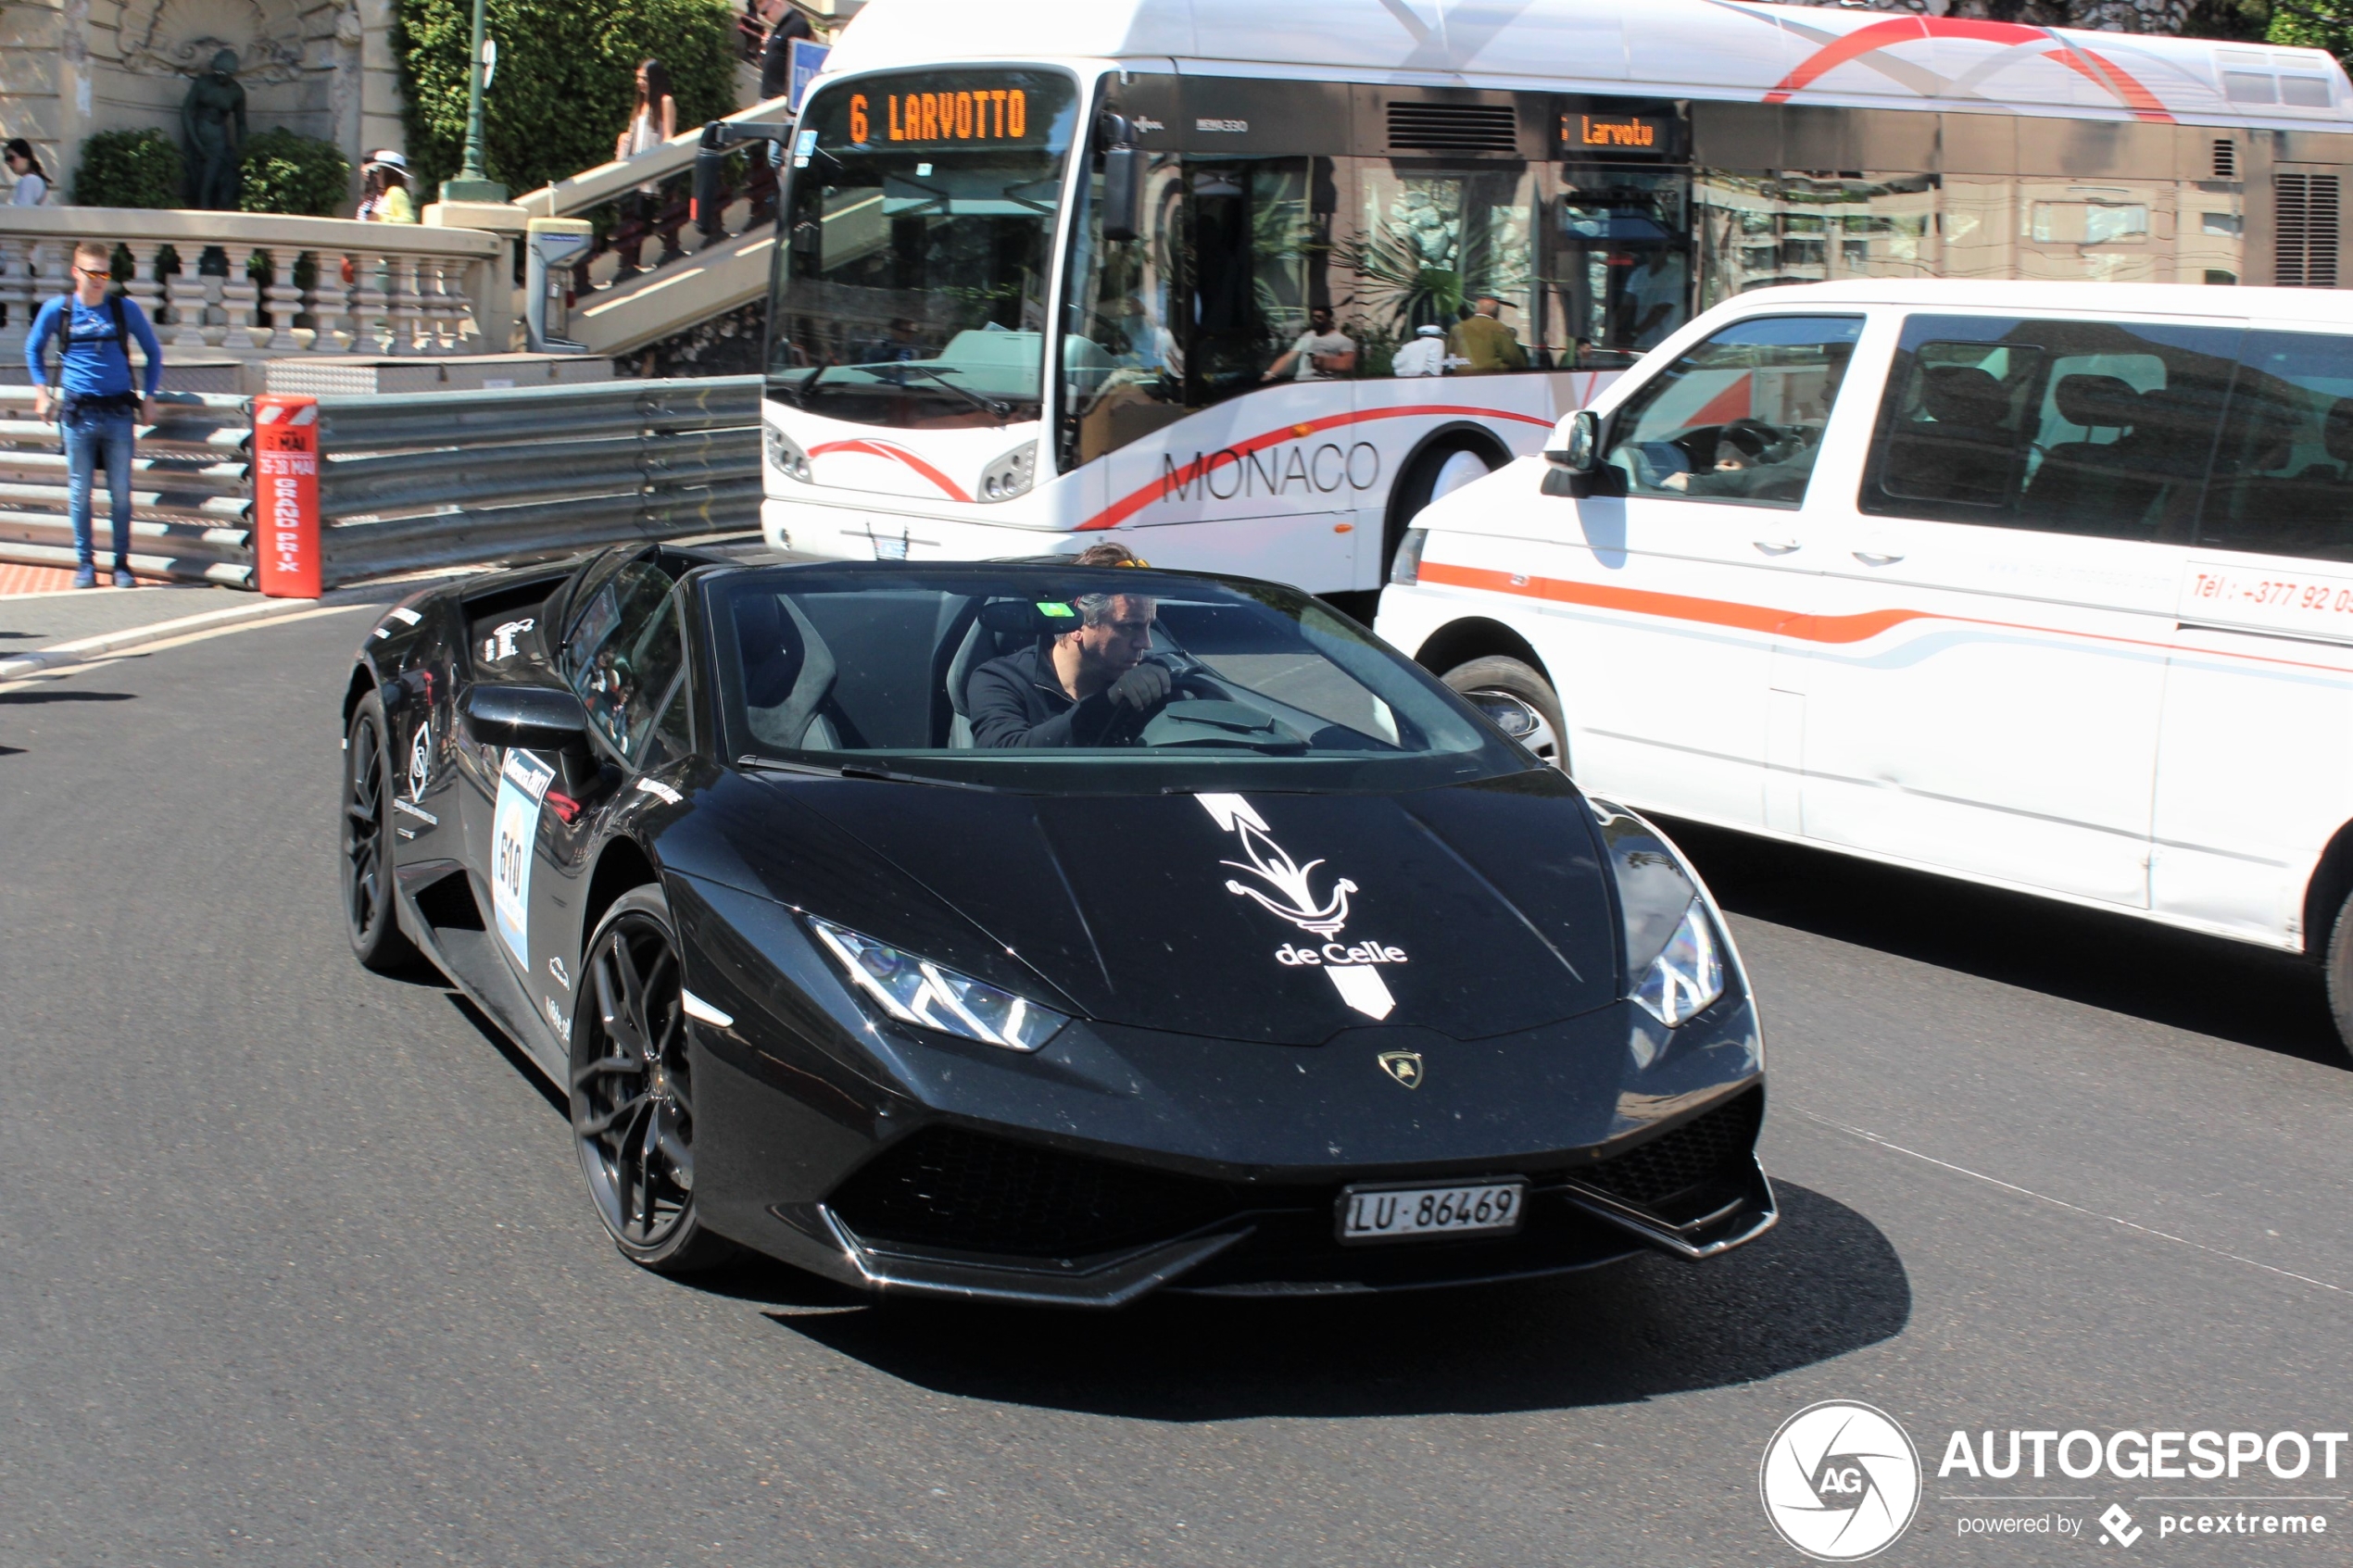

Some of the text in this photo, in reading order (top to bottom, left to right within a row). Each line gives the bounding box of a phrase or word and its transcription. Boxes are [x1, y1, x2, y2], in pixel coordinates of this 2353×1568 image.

[849, 89, 1026, 144] 6 LARVOTTO
[291, 459, 316, 476] MAI
[1163, 441, 1380, 504] MONACO
[273, 477, 300, 528] GRAND
[2194, 572, 2225, 598] Tél
[2301, 585, 2331, 608] 92
[499, 830, 522, 897] 610
[1275, 940, 1409, 965] de Celle
